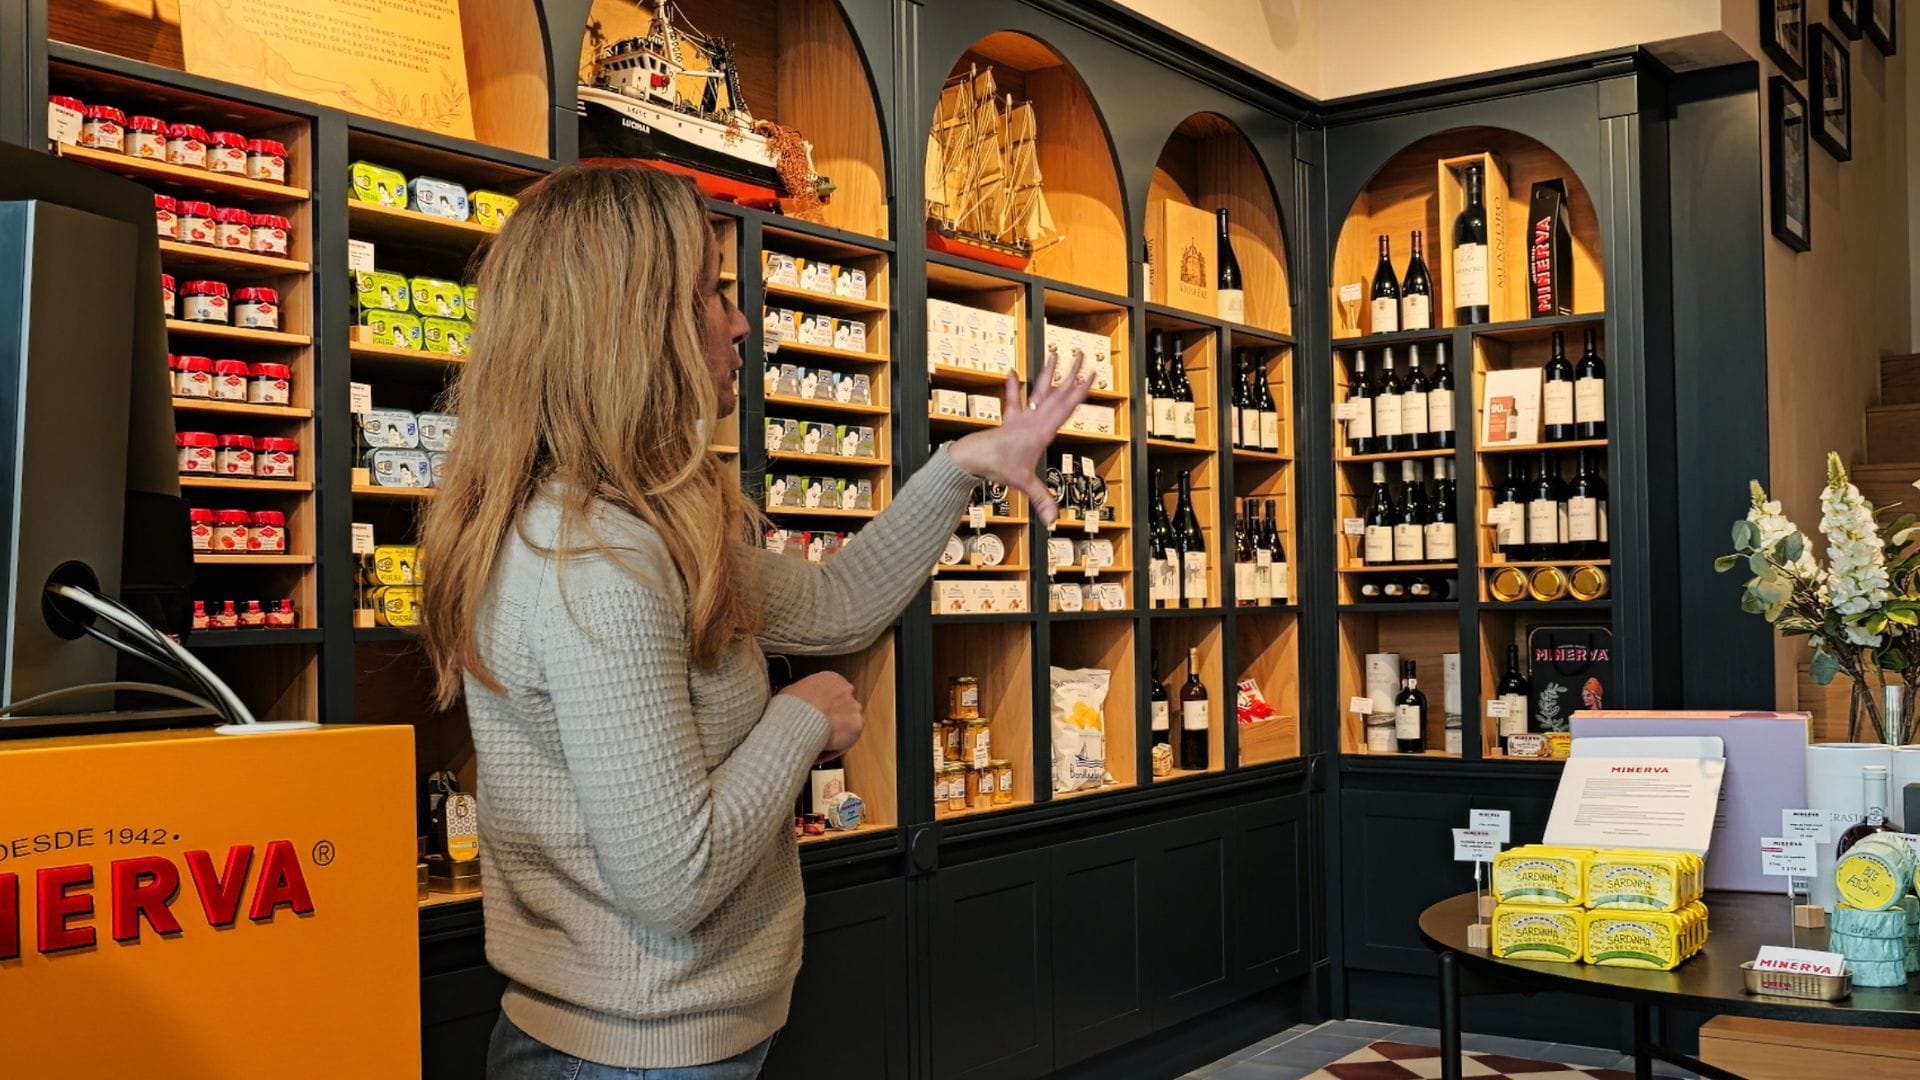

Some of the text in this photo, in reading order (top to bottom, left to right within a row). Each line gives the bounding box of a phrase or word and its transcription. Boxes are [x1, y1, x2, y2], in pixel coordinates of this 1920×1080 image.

[1535, 216, 1551, 312] MINERVA
[1610, 766, 1670, 774] MINERVA
[1515, 871, 1559, 885] SARDINHA
[1607, 878, 1652, 894] SARDINHA
[1515, 927, 1560, 941] SARDINHA
[1607, 934, 1652, 947] SARDINHA
[1760, 959, 1832, 976] MINERVA
